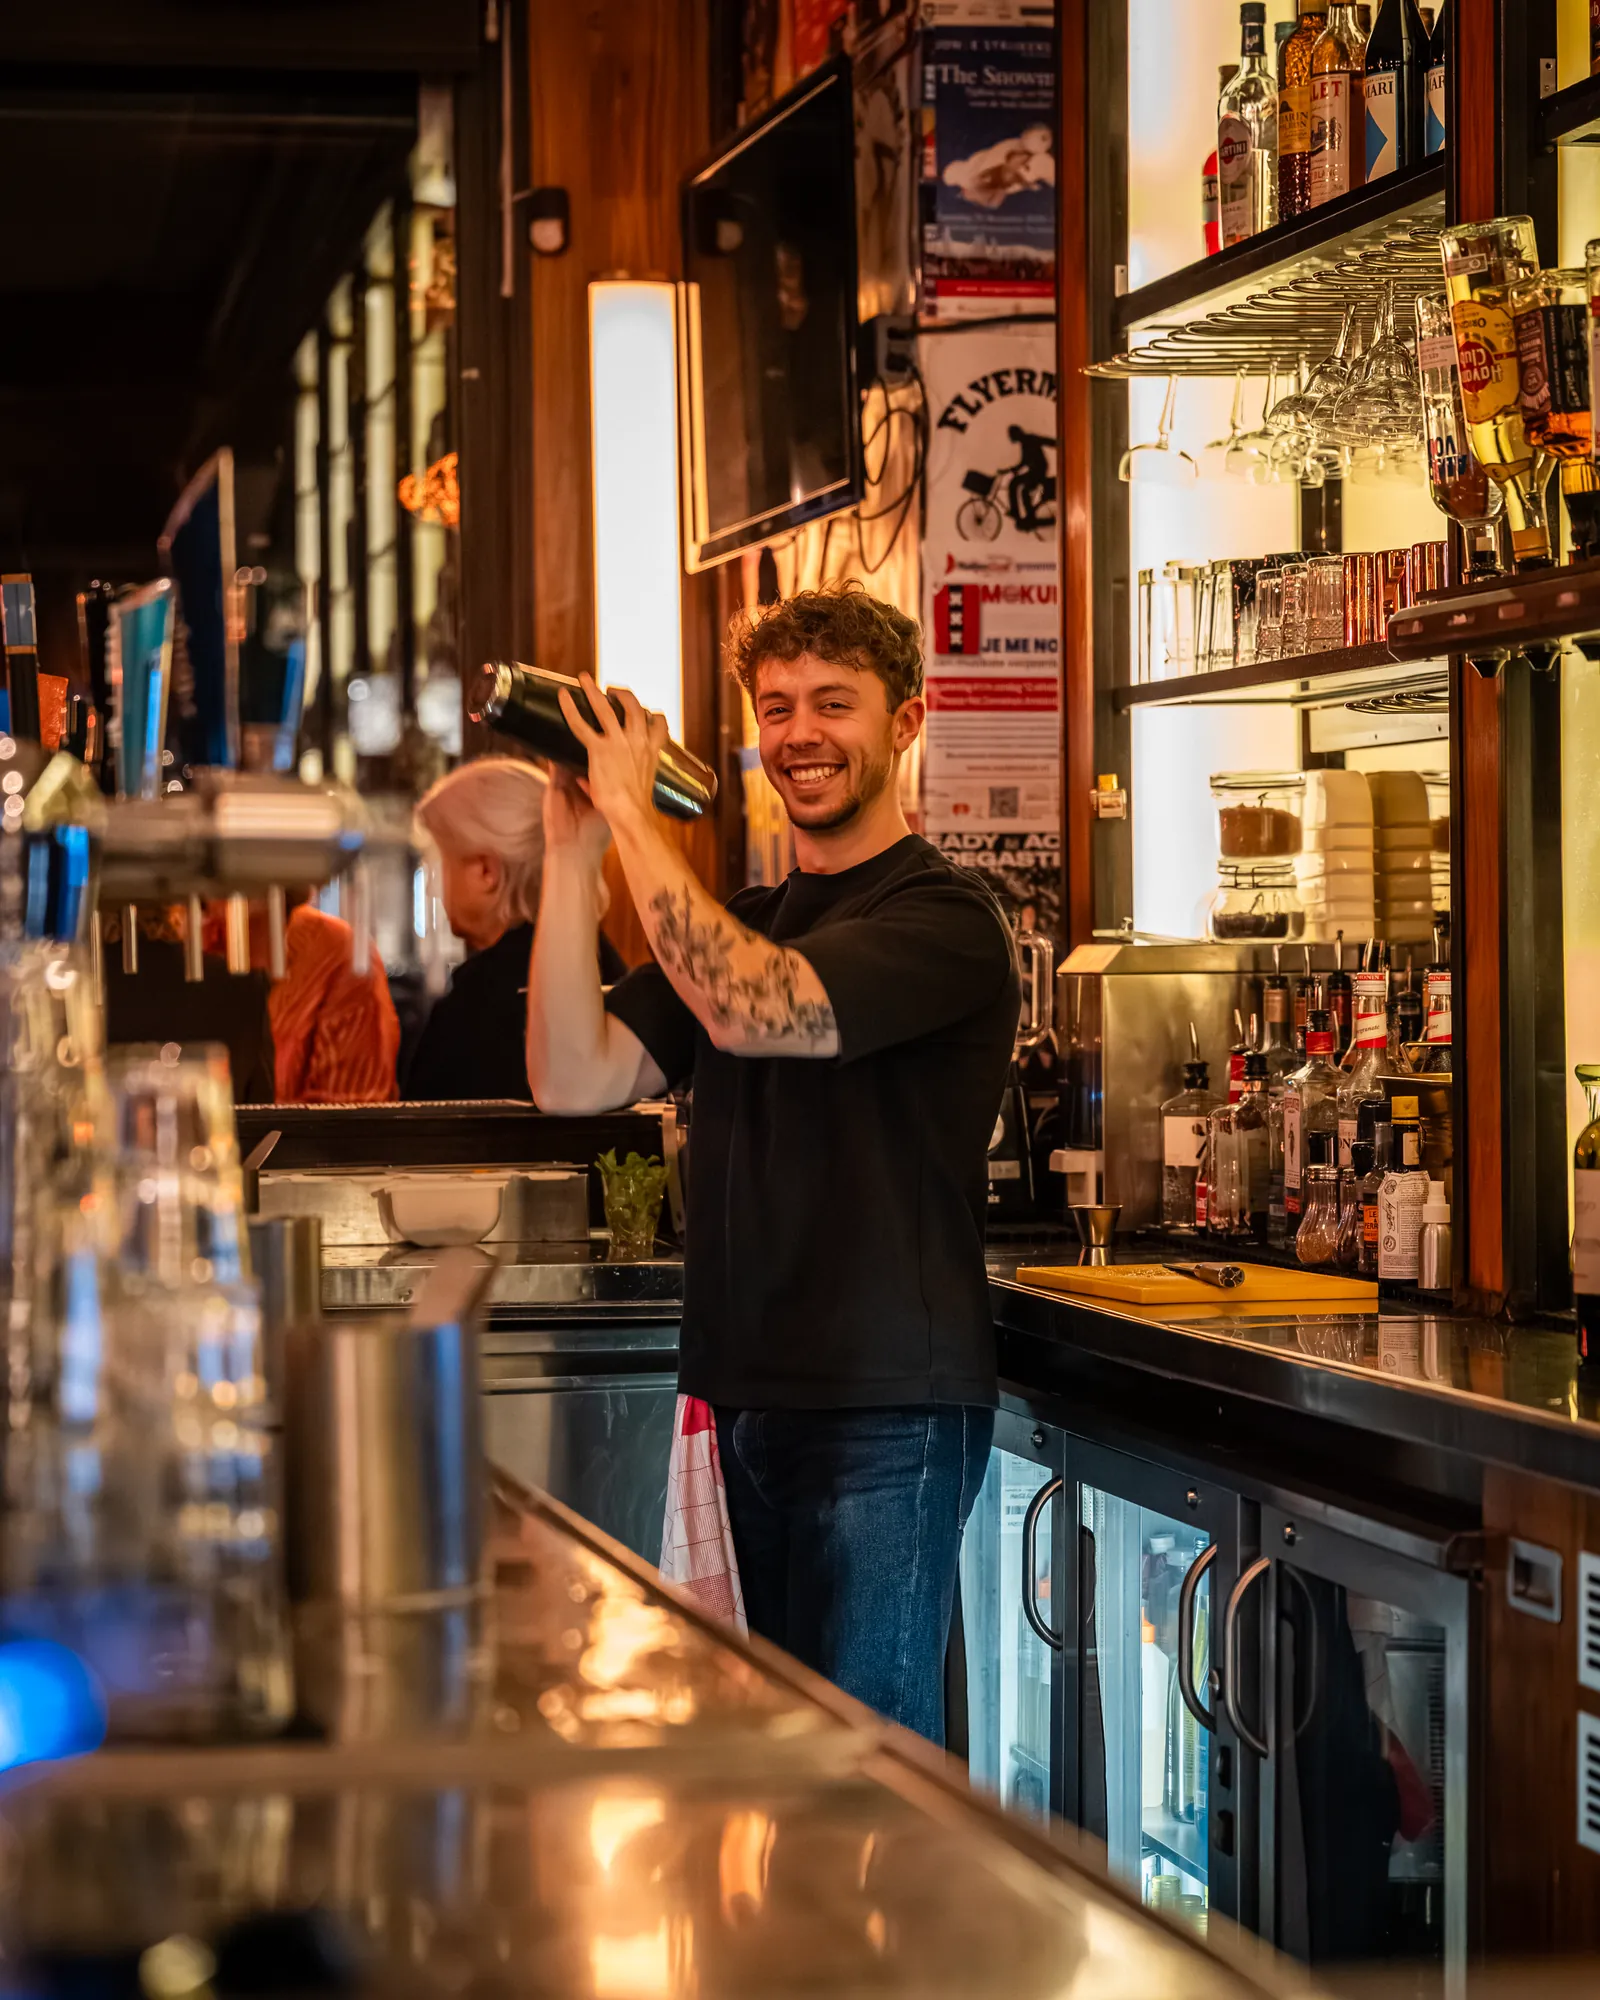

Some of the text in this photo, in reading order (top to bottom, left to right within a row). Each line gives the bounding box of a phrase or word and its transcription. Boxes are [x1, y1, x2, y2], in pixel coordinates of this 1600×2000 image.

[937, 63, 977, 84] The
[981, 584, 1057, 604] MOKU
[980, 638, 1000, 653] JE
[1005, 638, 1029, 653] ME
